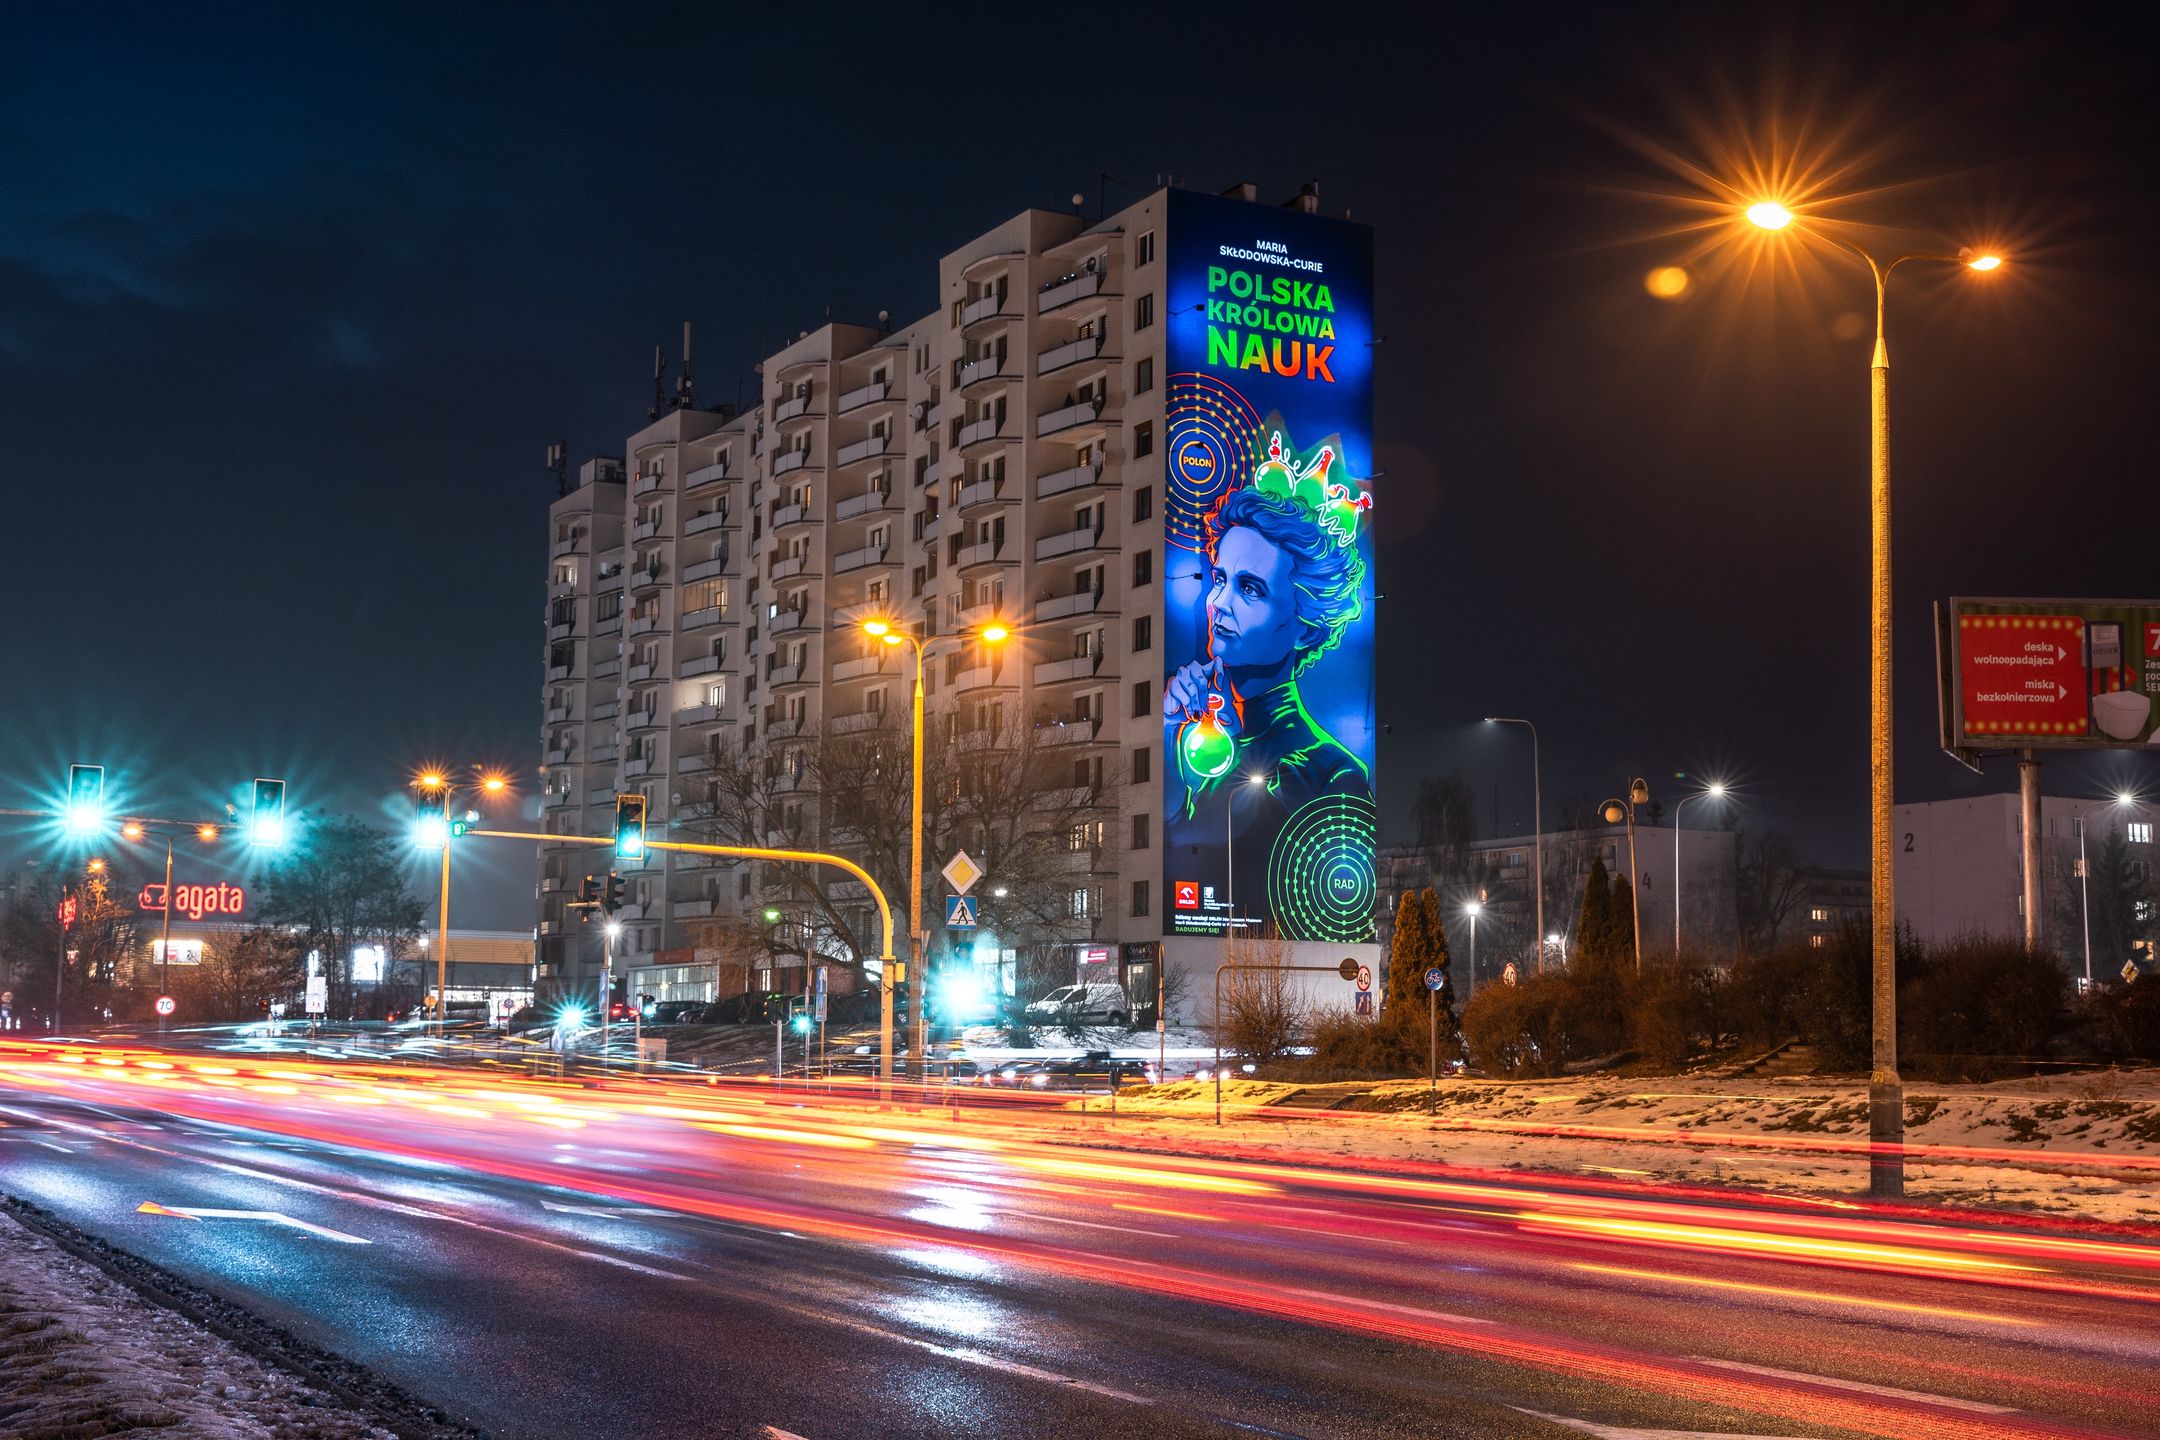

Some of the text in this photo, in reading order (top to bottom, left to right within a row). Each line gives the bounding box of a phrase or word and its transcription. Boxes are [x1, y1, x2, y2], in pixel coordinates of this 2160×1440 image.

[1256, 240, 1288, 255] MARIA
[1220, 245, 1323, 272] SKŁODOWSKA-CURIE
[1208, 265, 1335, 313] POLSKA
[1208, 298, 1335, 340] KRÓLOWA
[1208, 325, 1335, 383] NAUK
[1183, 456, 1212, 468] POLON
[2024, 642, 2054, 652] deska
[1974, 655, 2054, 667] wolnoopadająca
[2025, 679, 2055, 690] miska
[1904, 832, 1915, 853] 2
[1334, 878, 1355, 889] RAD
[1642, 872, 1651, 890] 4
[175, 881, 243, 920] agata
[1359, 973, 1368, 985] 40
[160, 1001, 172, 1010] 70
